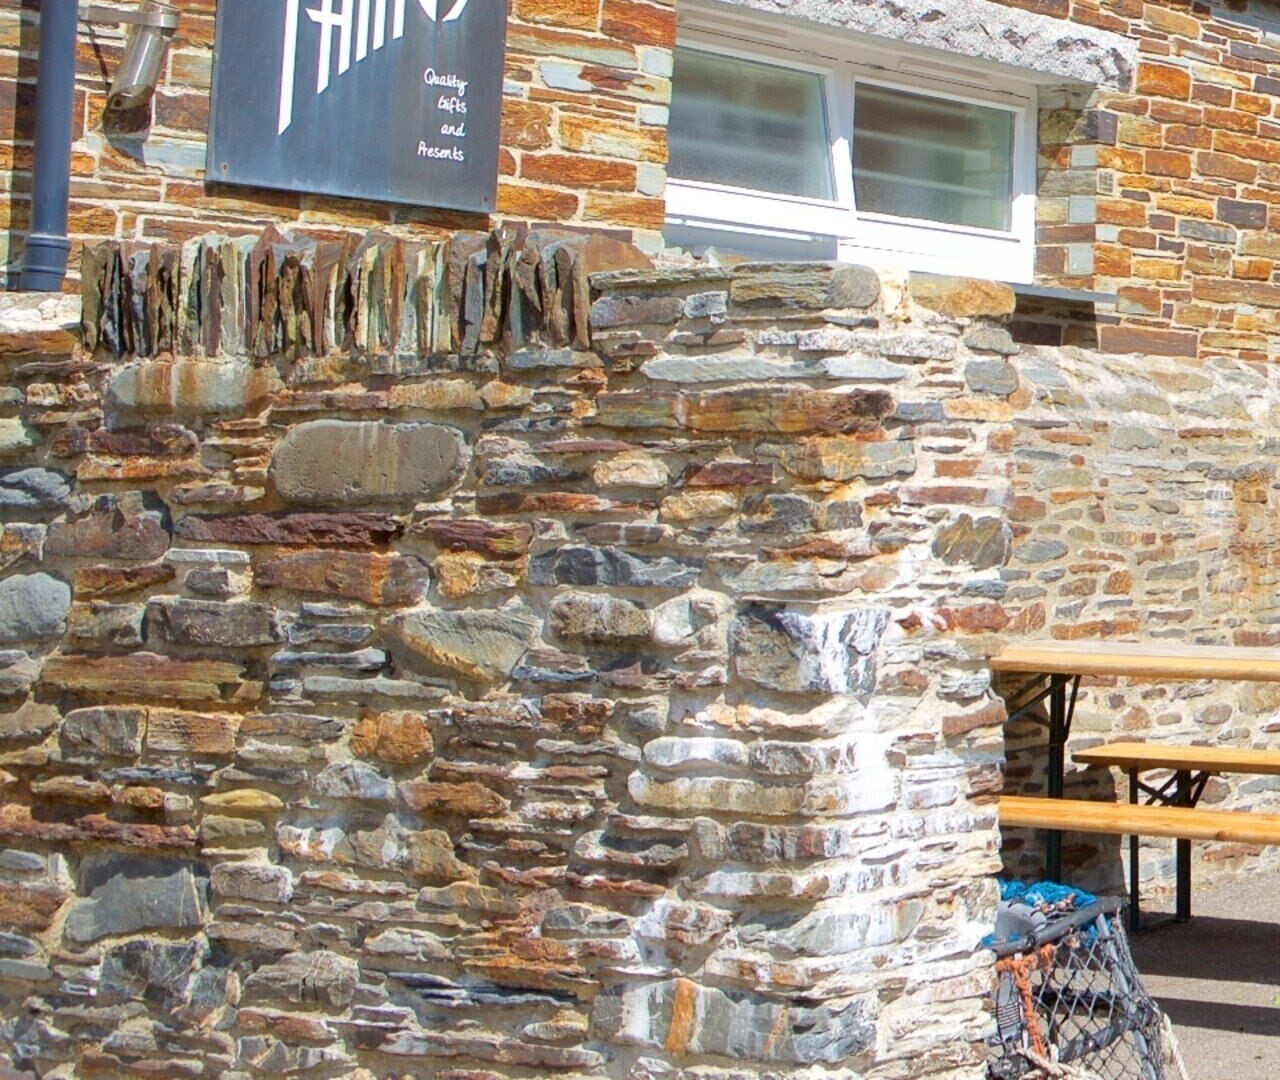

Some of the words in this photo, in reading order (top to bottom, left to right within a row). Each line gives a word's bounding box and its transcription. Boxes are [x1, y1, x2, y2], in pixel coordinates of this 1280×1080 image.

[424, 67, 468, 96] Quality
[437, 95, 467, 114] Gifts
[441, 122, 465, 137] and
[417, 140, 464, 161] Presents
